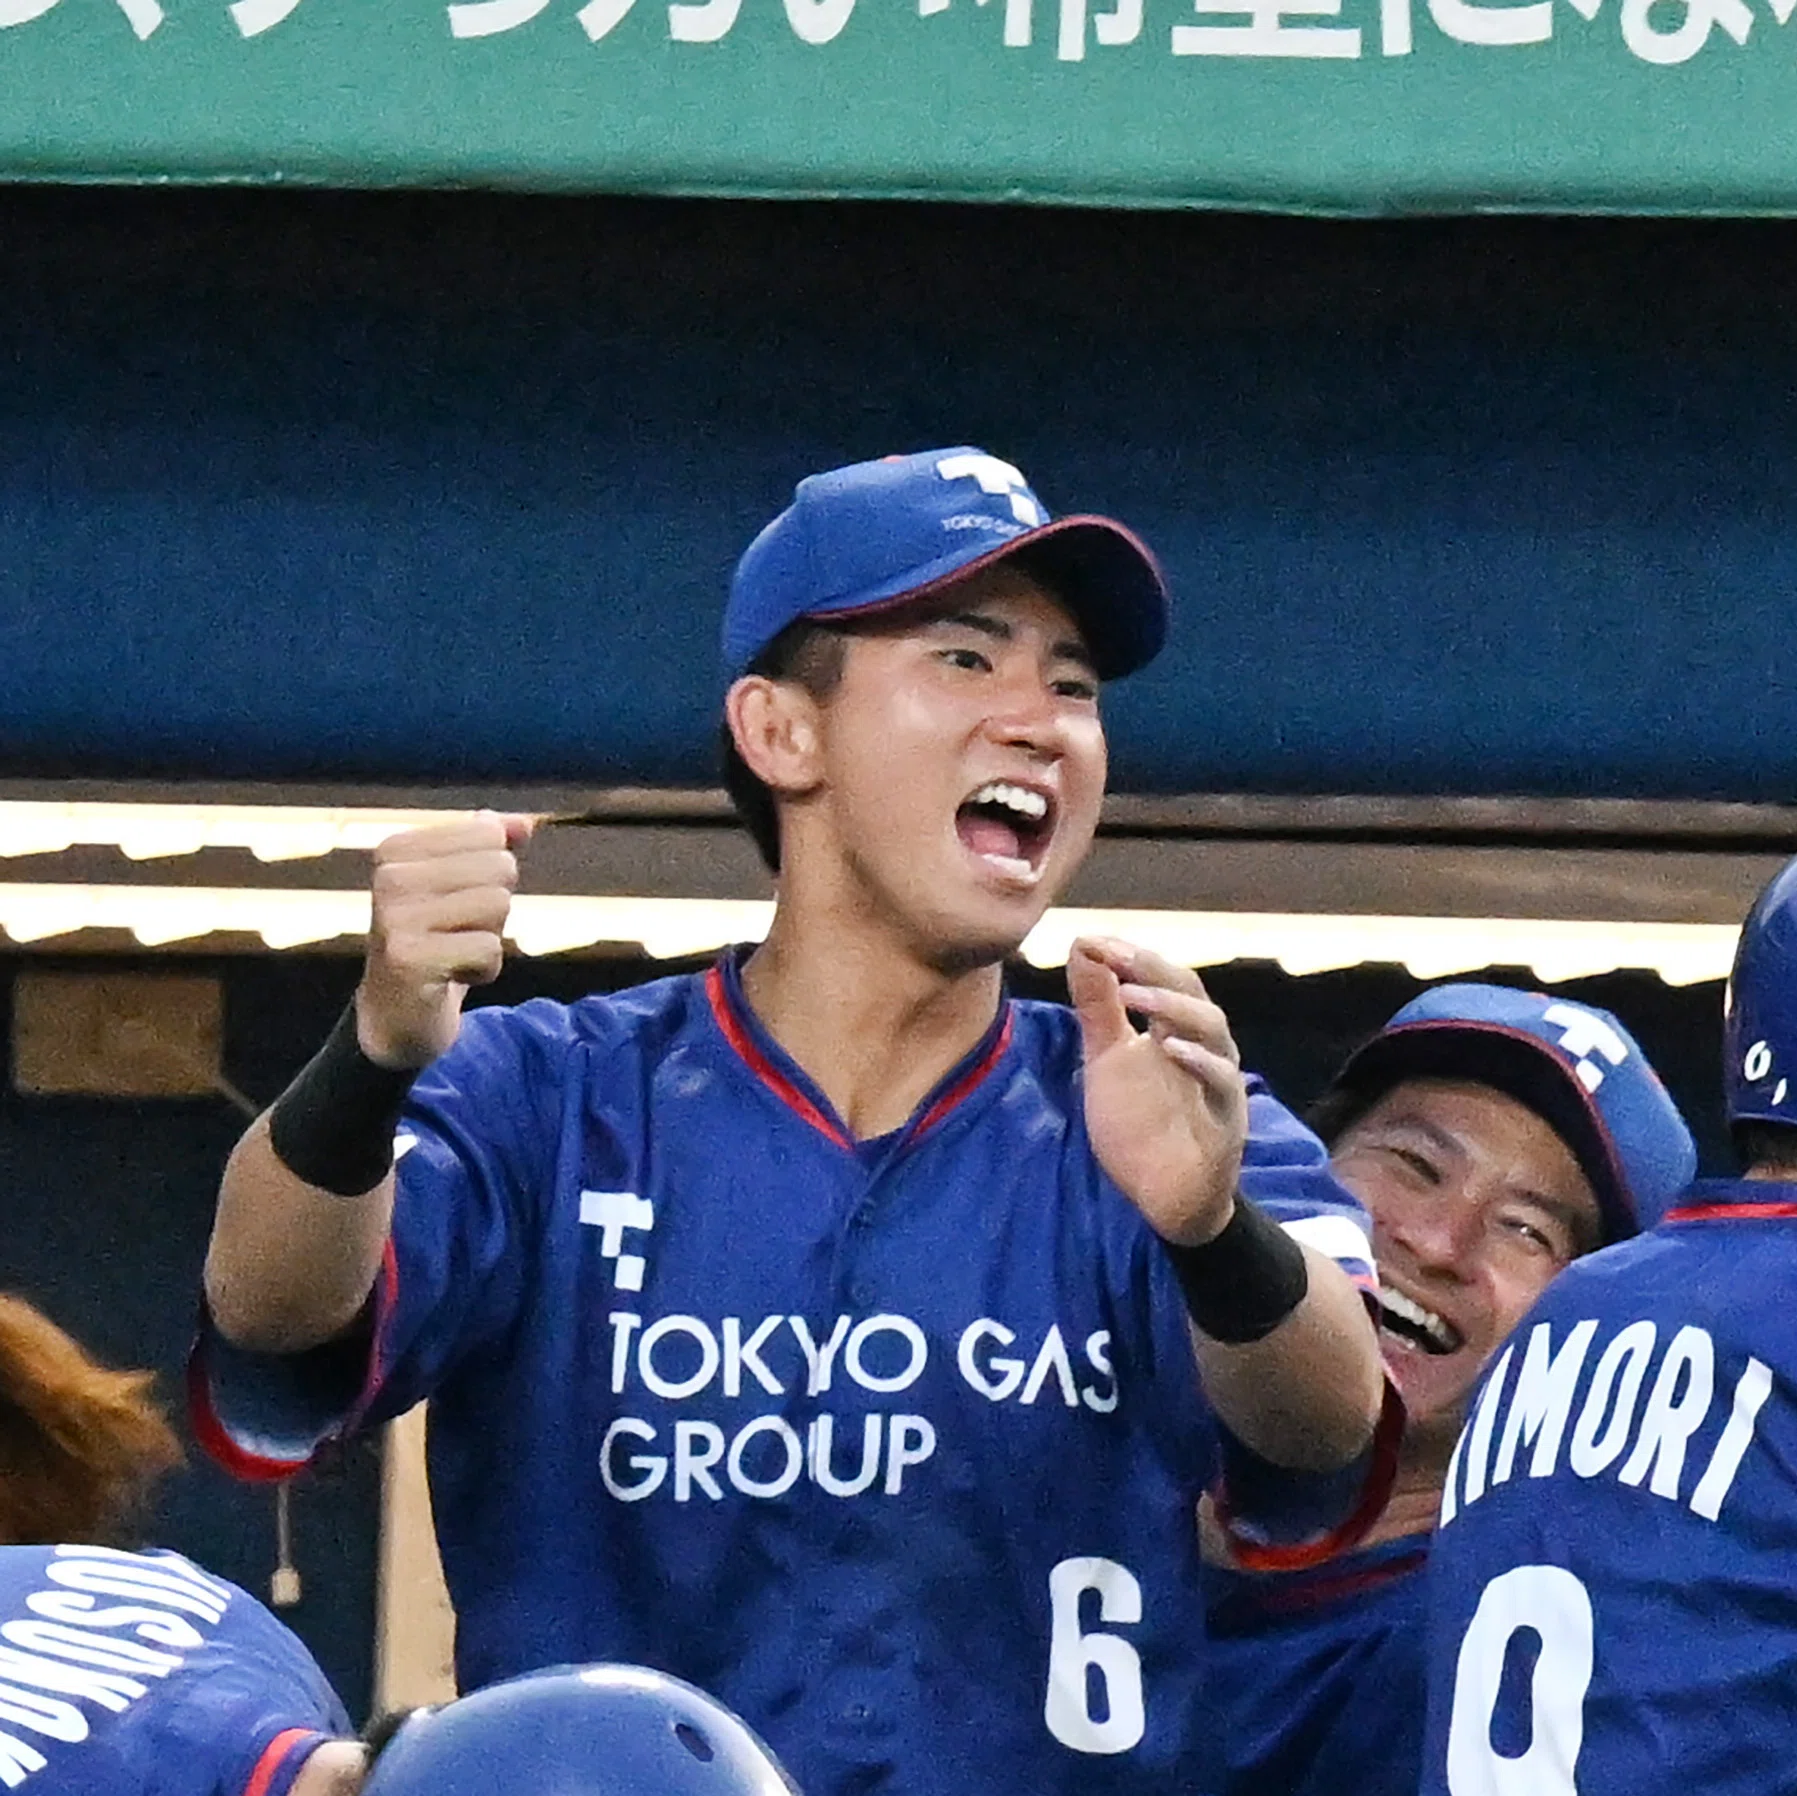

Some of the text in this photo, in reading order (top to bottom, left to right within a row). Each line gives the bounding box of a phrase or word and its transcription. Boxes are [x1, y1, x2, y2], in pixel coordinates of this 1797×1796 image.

[608, 1312, 1120, 1415] TOKYO GAS
[600, 1411, 937, 1502] GROUP
[1043, 1556, 1145, 1755] 6
